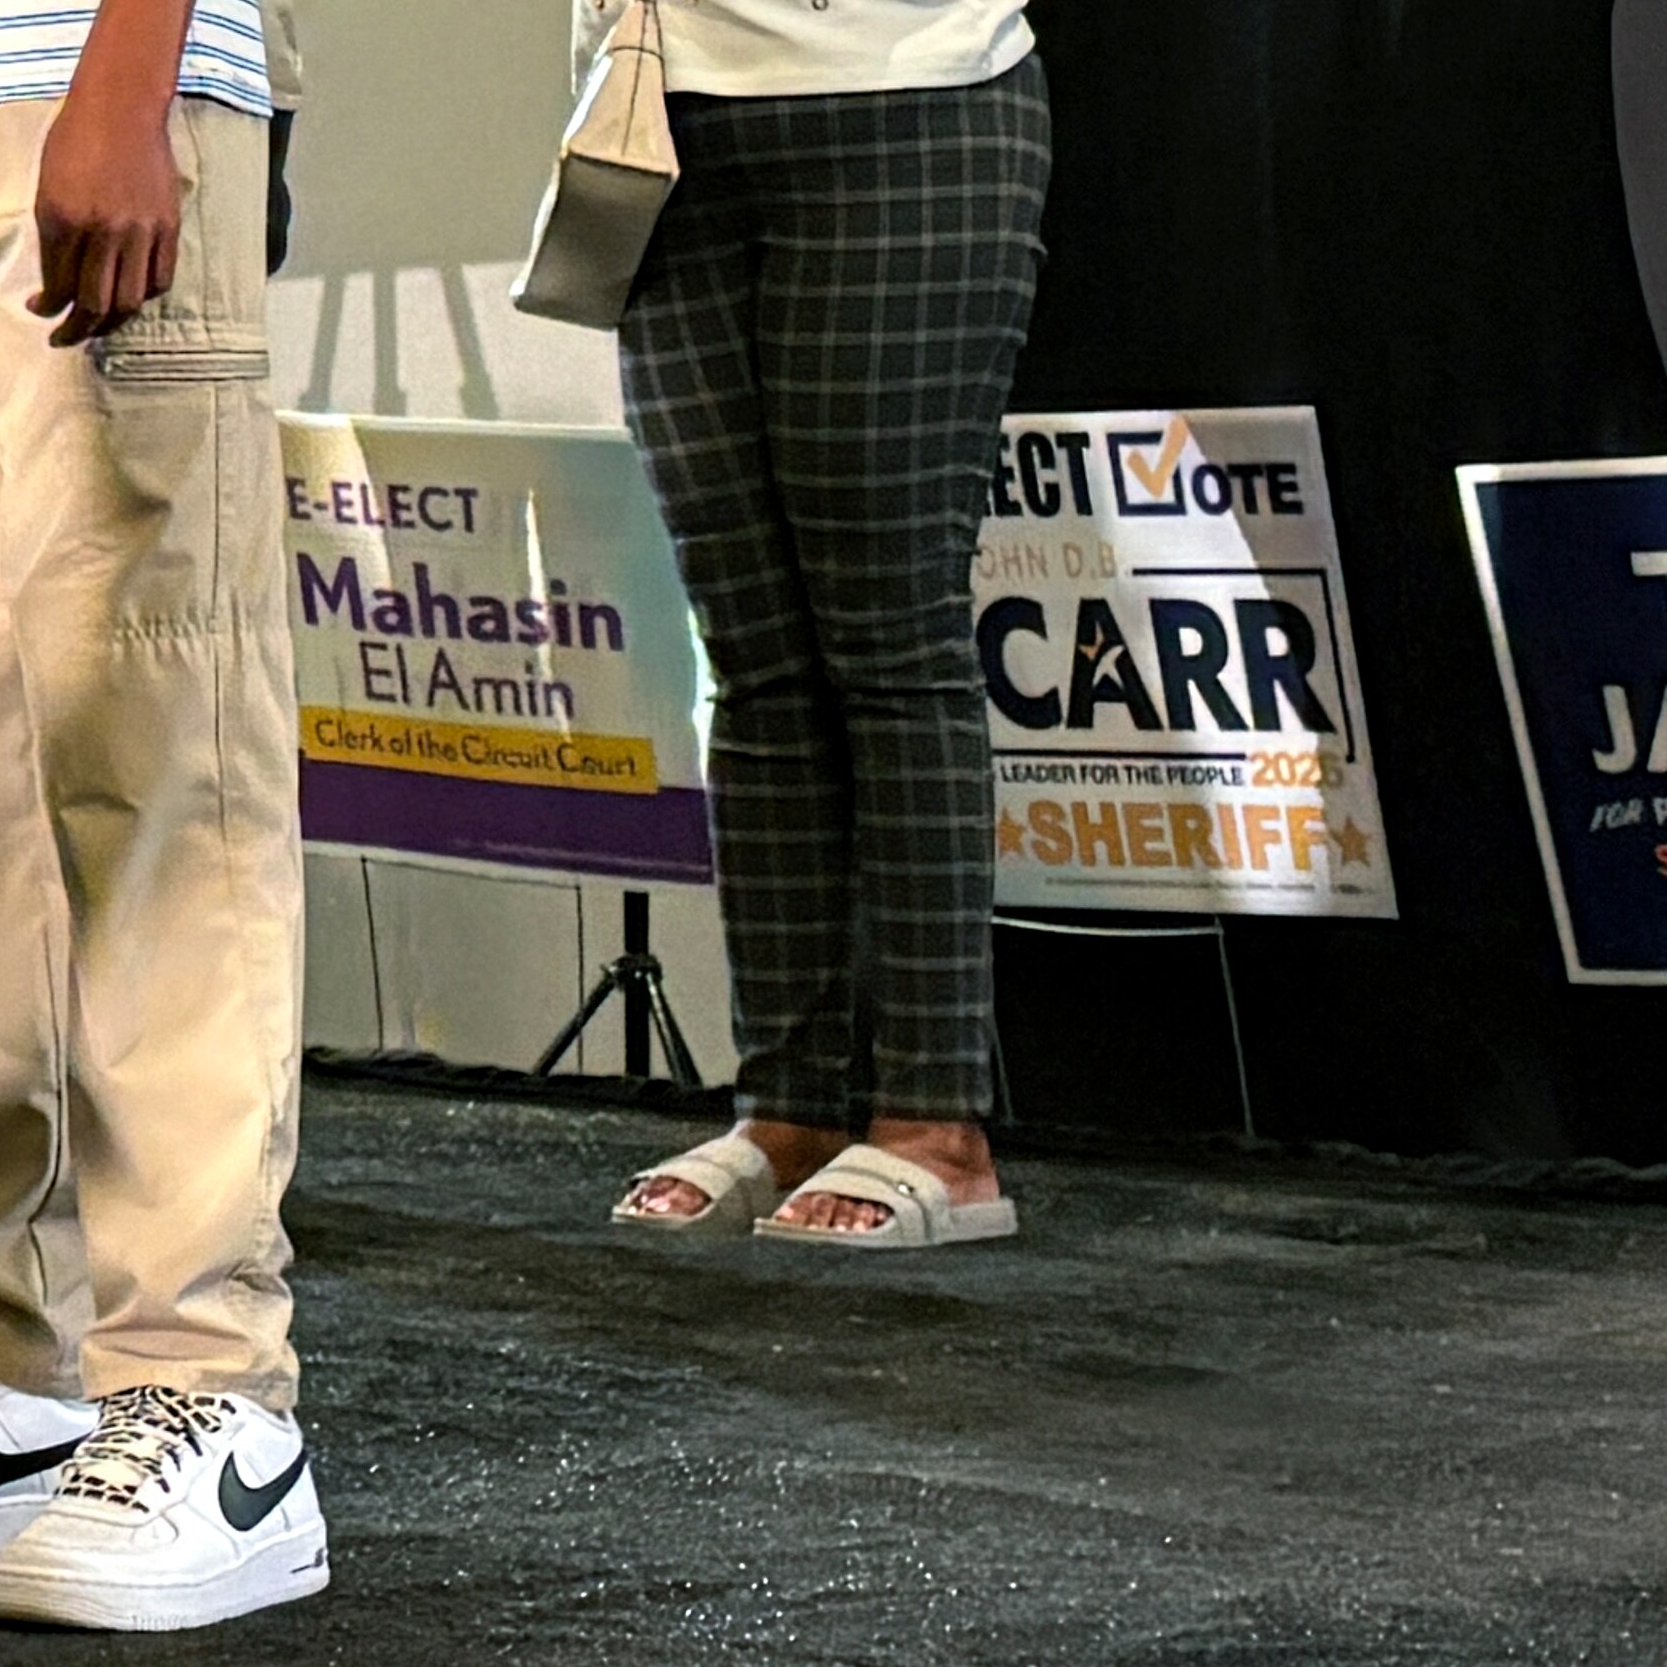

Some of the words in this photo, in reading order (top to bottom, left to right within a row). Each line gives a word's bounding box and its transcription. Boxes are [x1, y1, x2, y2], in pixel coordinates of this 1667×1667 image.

[296, 551, 625, 652] Mahasin
[359, 641, 409, 704] El
[427, 647, 574, 720] Amin
[975, 595, 1338, 734] CARR
[315, 720, 384, 753] Clerk
[390, 729, 412, 756] of
[416, 730, 459, 763] the
[462, 735, 553, 771] Circuit
[557, 743, 636, 777] Court
[1000, 764, 1076, 784] LEADER
[1080, 764, 1119, 785] FOR
[1124, 765, 1164, 785] THE
[1167, 766, 1245, 786] PEOPLE
[1026, 800, 1326, 871] SHERIFF
